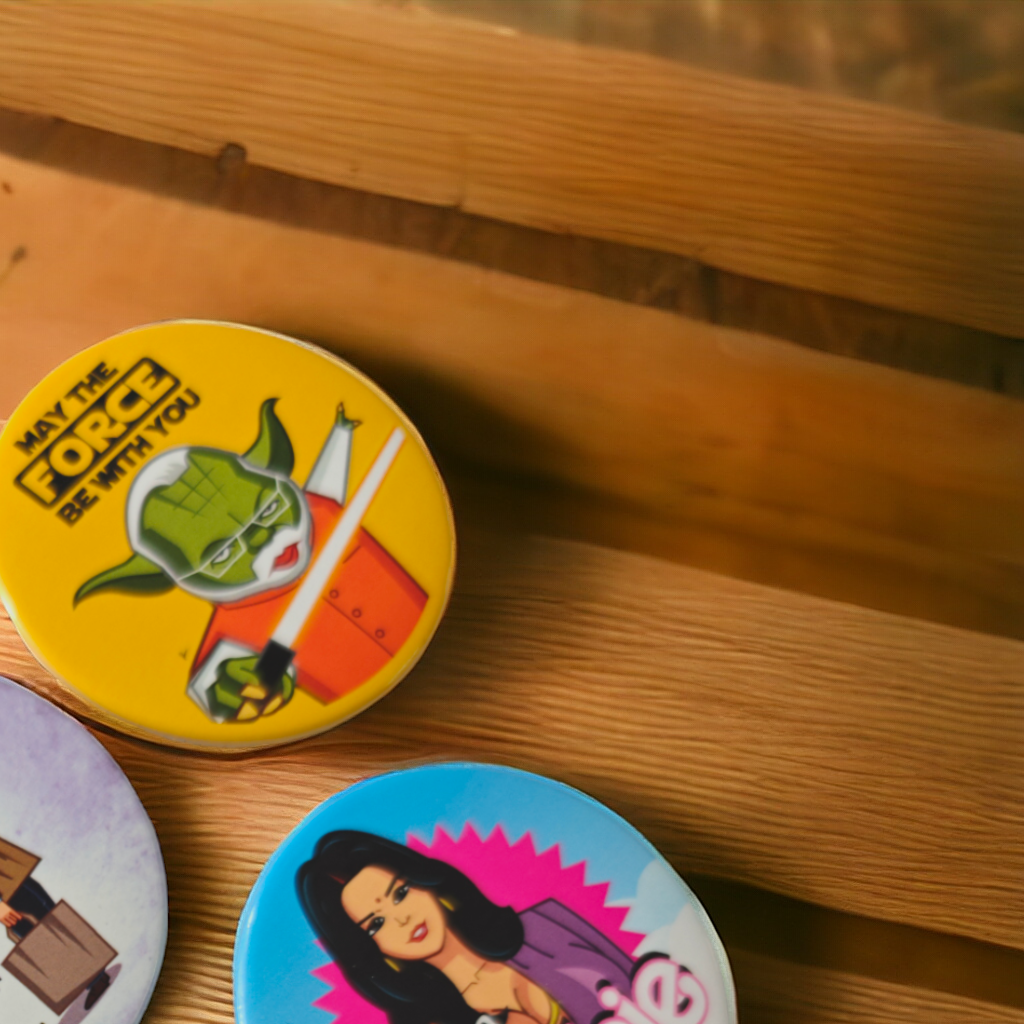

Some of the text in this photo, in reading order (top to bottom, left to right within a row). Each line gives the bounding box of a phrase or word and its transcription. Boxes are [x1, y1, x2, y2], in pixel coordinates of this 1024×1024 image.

[13, 361, 119, 457] MAY THE
[19, 361, 177, 506] FORCE
[55, 387, 201, 528] BE WITH YOU
